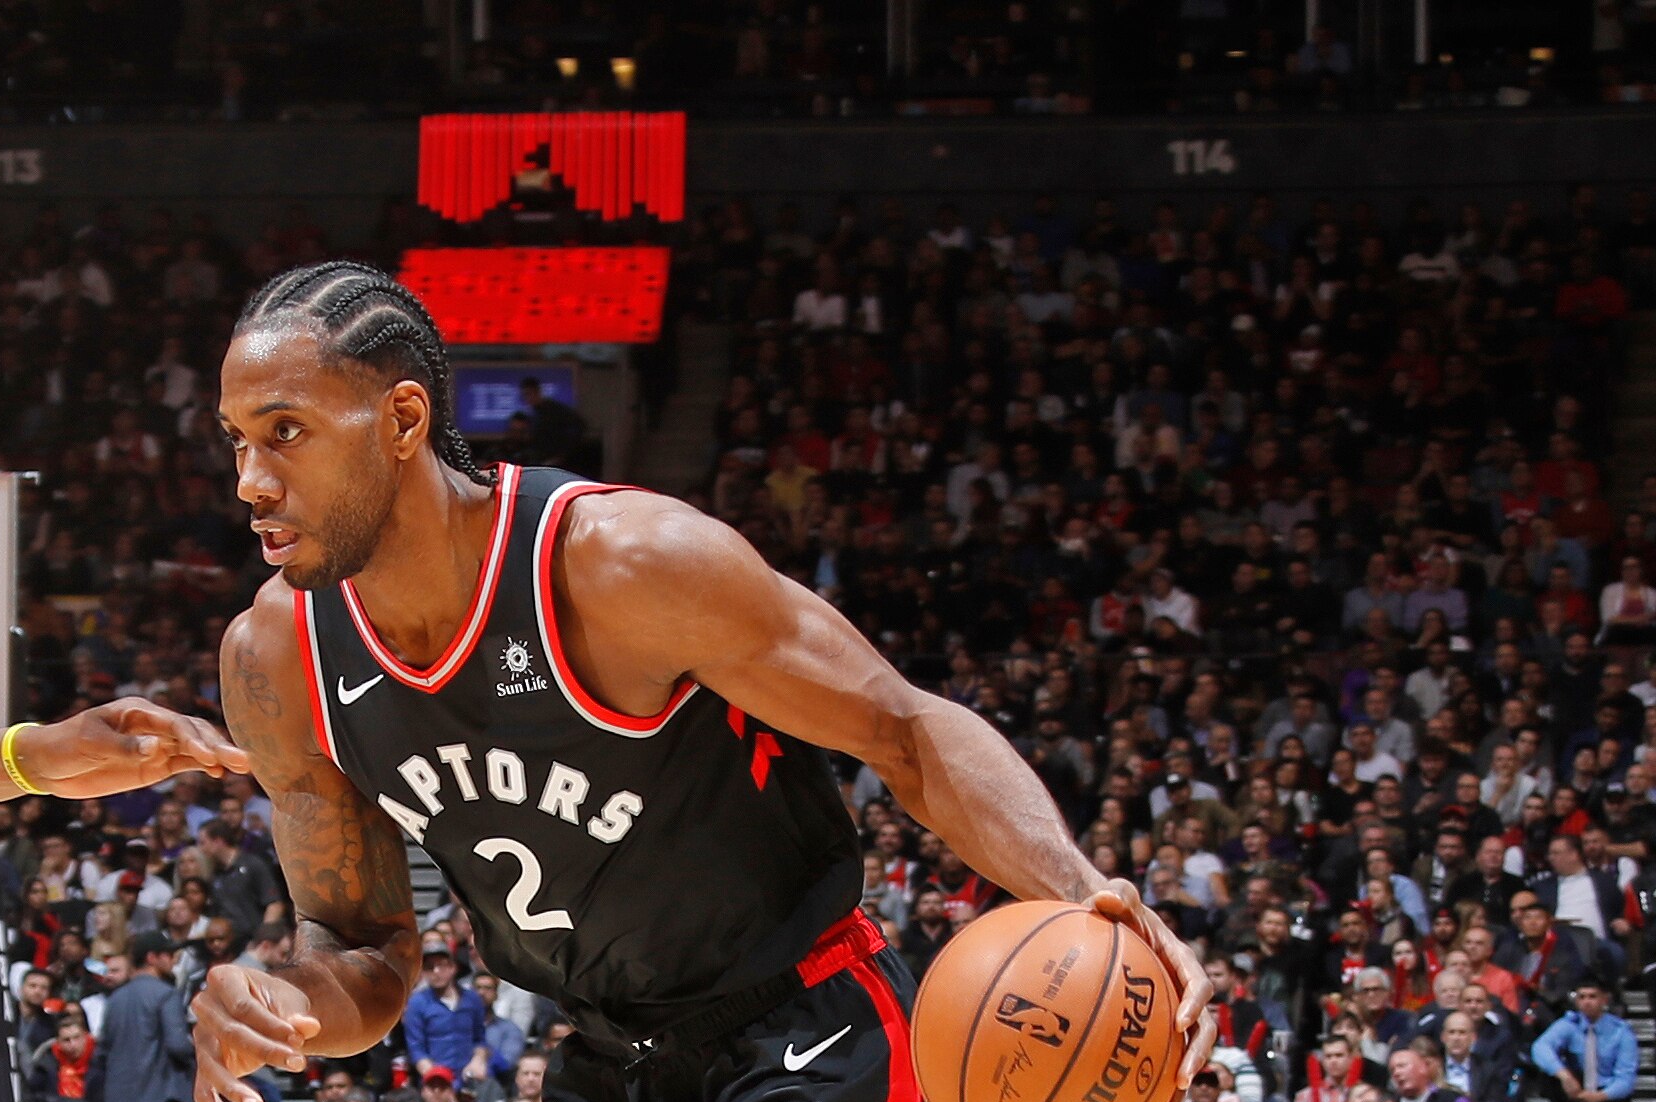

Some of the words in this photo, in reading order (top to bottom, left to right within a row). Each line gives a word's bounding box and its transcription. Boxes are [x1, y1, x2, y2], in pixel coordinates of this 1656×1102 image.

[1167, 140, 1235, 174] 114
[496, 682, 524, 697] Sun
[524, 675, 548, 691] Life
[378, 743, 643, 844] APTORS
[473, 838, 574, 931] 2
